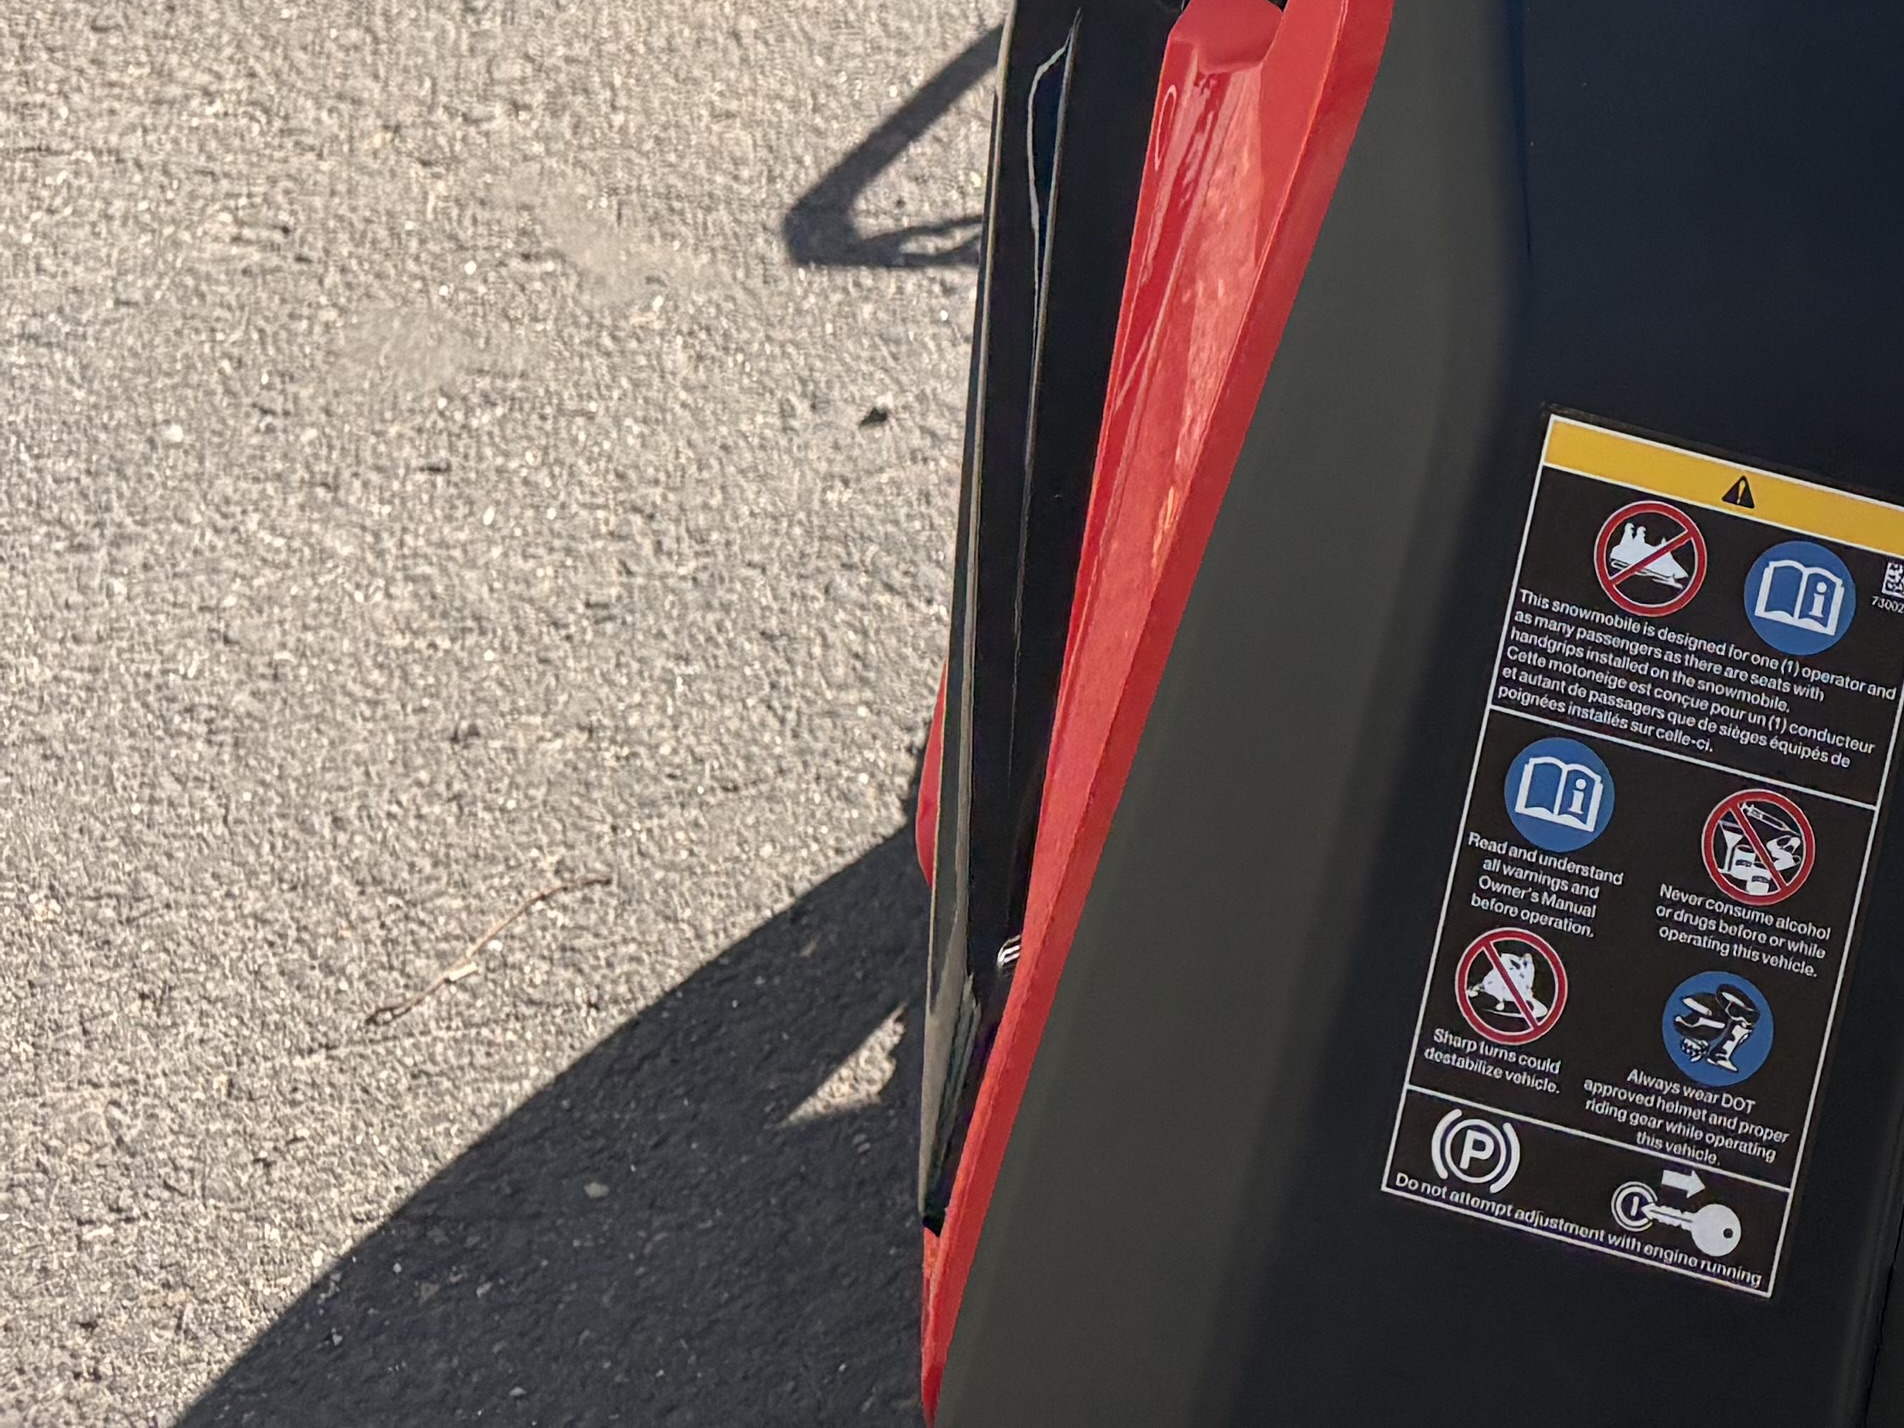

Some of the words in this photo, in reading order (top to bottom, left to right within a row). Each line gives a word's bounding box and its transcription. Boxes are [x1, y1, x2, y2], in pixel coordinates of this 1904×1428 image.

[1519, 588, 1550, 609] This
[1551, 600, 1641, 634] snowmobile
[1642, 621, 1656, 637] is
[1657, 627, 1727, 656] designed
[1728, 643, 1751, 661] for
[1750, 653, 1779, 670] one
[1780, 658, 1800, 678] (1)
[1801, 666, 1867, 692] operator
[1867, 684, 1897, 701] and
[1506, 645, 1547, 668] Cette
[1548, 659, 1628, 690] motoneige
[1628, 680, 1652, 697] est
[1653, 687, 1710, 711] conçue
[1709, 702, 1747, 720] pour
[1747, 711, 1767, 727] un
[1768, 714, 1787, 735] (1)
[1788, 723, 1876, 754] conducteur
[1468, 831, 1508, 855] Read
[1508, 845, 1538, 863] and
[1538, 854, 1624, 886] understand
[1482, 858, 1502, 873] all
[1502, 863, 1569, 892] warnings
[1570, 882, 1600, 899] and
[1470, 892, 1519, 918] before
[1520, 909, 1594, 938] operation.
[1478, 875, 1540, 903] Owner's
[1541, 891, 1597, 918] Manual
[1659, 883, 1706, 907] Never
[1705, 898, 1775, 926] consume
[1775, 916, 1831, 940] alcohol
[1395, 1172, 1419, 1191] Do
[1420, 1182, 1448, 1200] not
[1449, 1190, 1514, 1217] attempt
[1514, 1209, 1606, 1242] adjustment
[1607, 1233, 1642, 1253] with
[1643, 1244, 1699, 1268] engine
[1700, 1259, 1762, 1289] running
